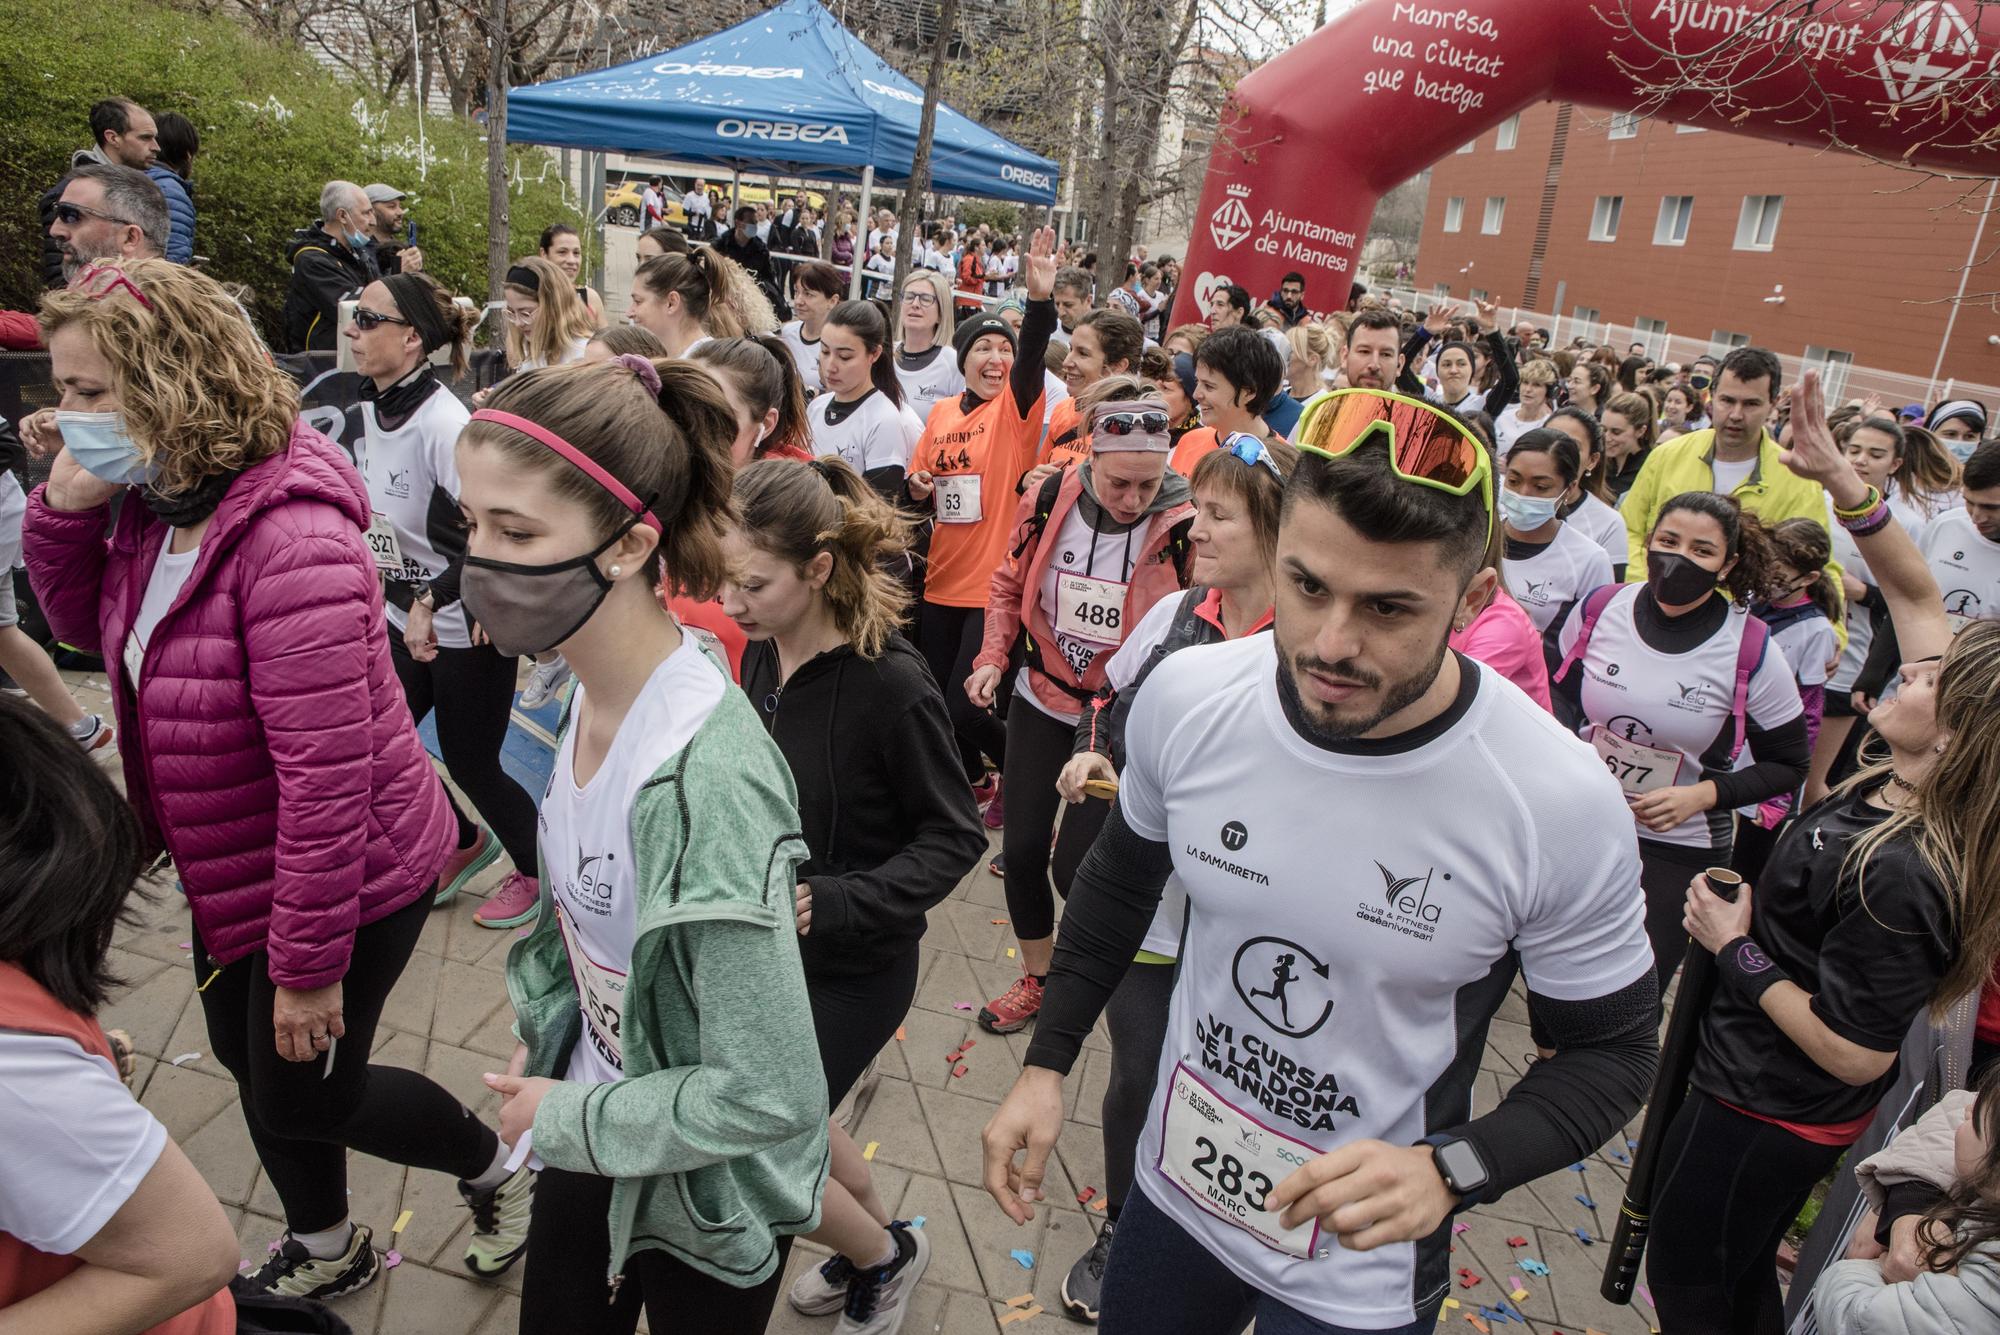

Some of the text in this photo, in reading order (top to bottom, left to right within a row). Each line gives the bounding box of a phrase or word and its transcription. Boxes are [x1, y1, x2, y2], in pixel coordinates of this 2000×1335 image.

[1392, 2, 1498, 41] Manresa,
[653, 63, 804, 79] ORBEA
[1373, 35, 1504, 78] una ciutat
[1363, 68, 1484, 114] que batega
[716, 119, 849, 145] ORBEA
[1001, 164, 1050, 191] ORBEA
[1260, 209, 1356, 249] Ajuntament
[1255, 233, 1348, 272] de Manresa
[945, 493, 960, 510] 53
[368, 533, 394, 555] 327
[1075, 602, 1120, 628] 488
[1605, 755, 1653, 784] 677
[1226, 827, 1245, 846] TT
[1186, 844, 1269, 886] LA SAMARRETTA
[1373, 859, 1442, 924] Vela
[1359, 902, 1384, 916] CLUB
[1396, 915, 1435, 933] FITNESS
[1196, 1018, 1361, 1118] DE LA DONA
[1209, 1012, 1339, 1093] VI CURSA
[1198, 1097, 1215, 1113] CURSA
[1202, 1049, 1336, 1132] MANRESA
[1189, 1101, 1215, 1123] MANRESA
[1206, 1109, 1223, 1124] DONA
[1192, 1136, 1273, 1212] 283
[1207, 1185, 1246, 1217] MARC
